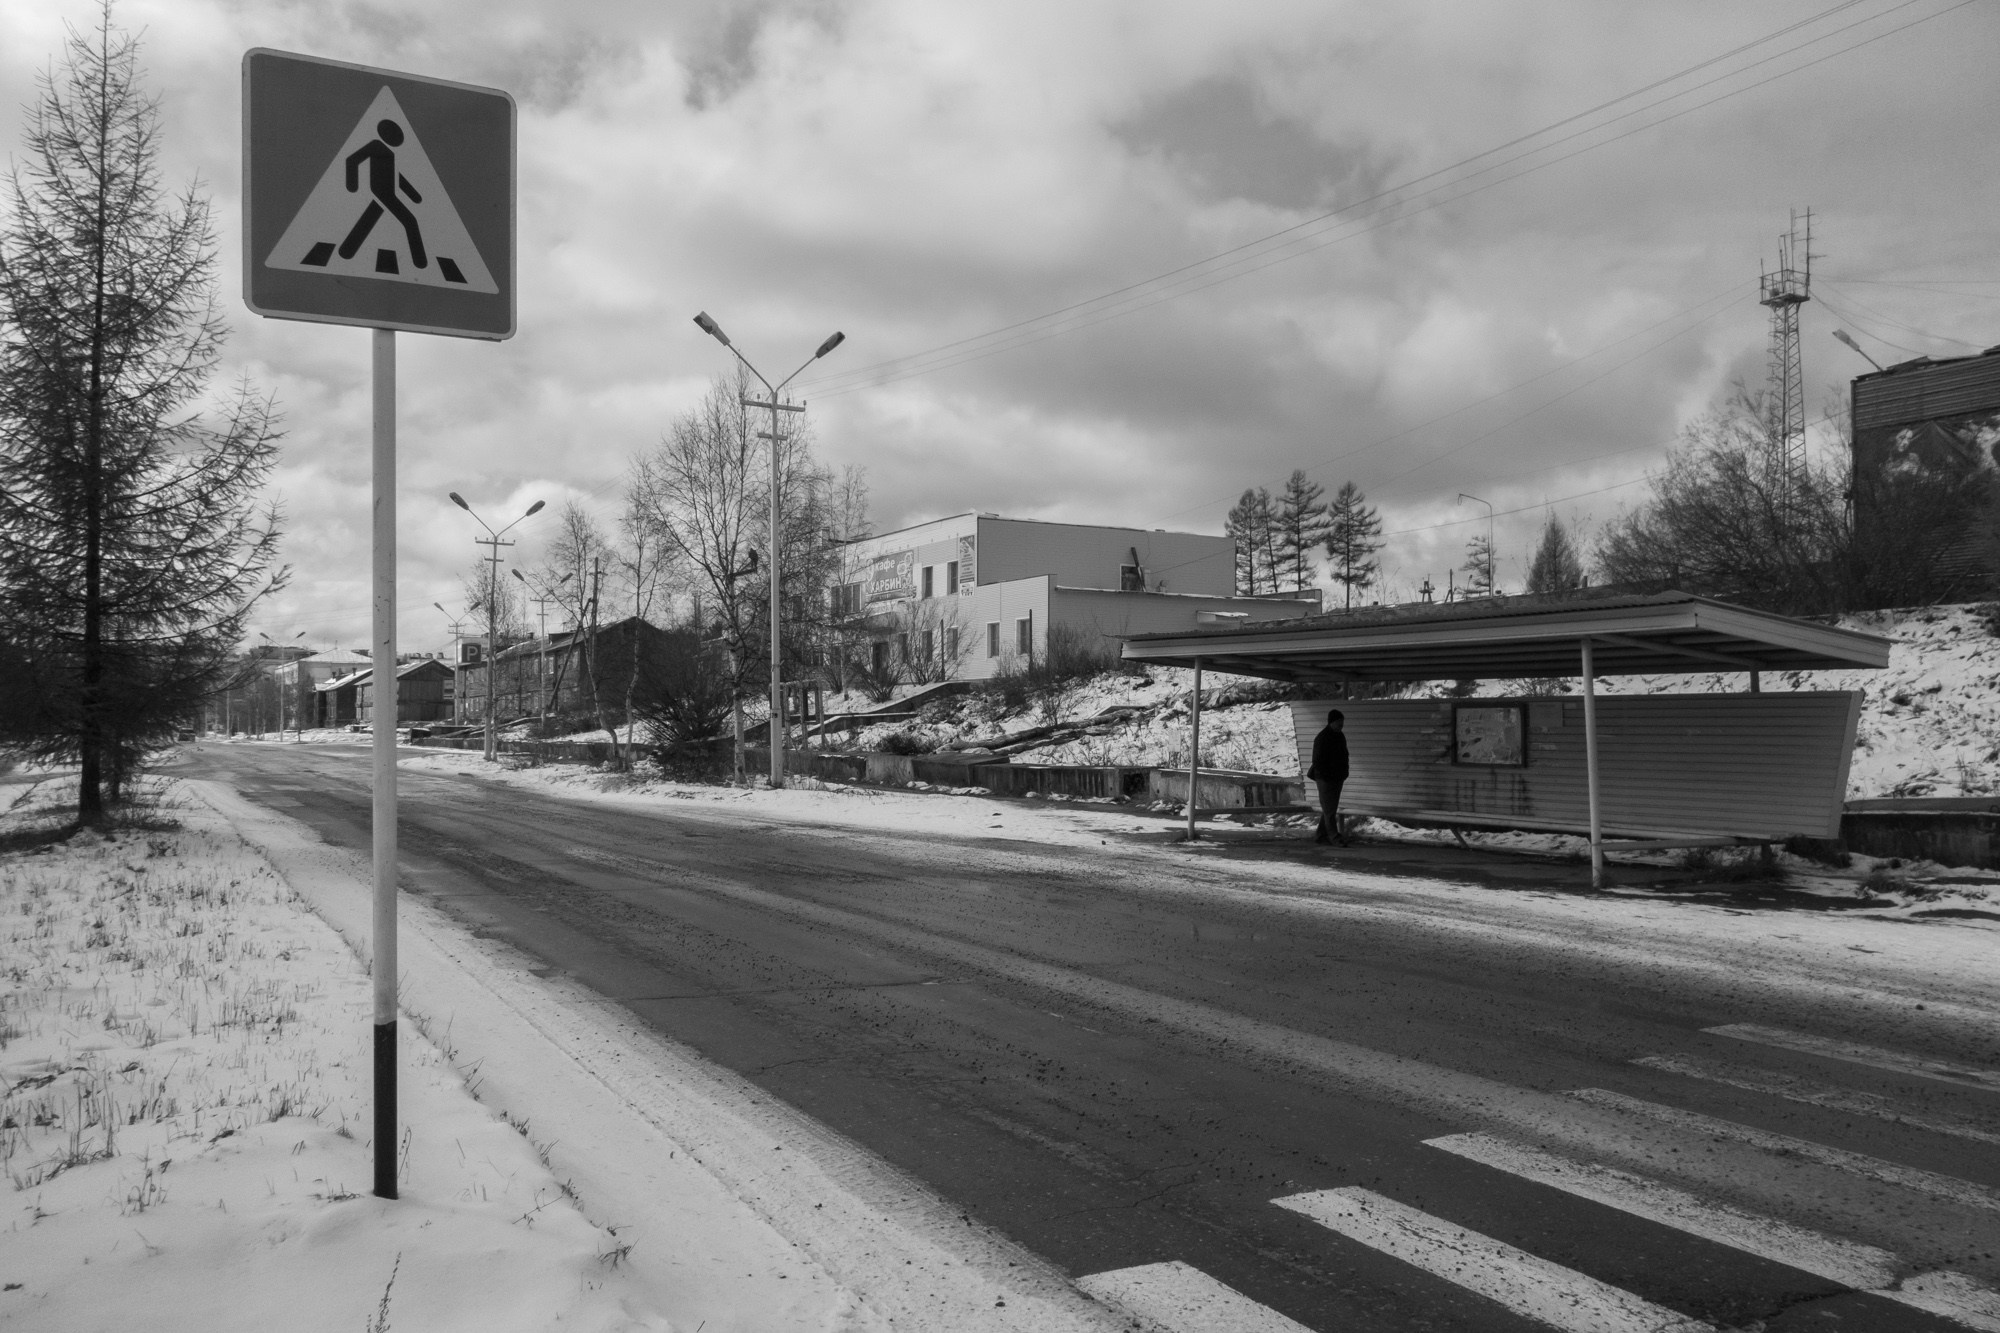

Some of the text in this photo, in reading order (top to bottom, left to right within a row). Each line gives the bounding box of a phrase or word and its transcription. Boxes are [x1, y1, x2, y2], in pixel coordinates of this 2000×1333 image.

[875, 558, 895, 572] кафе
[870, 577, 901, 593] ХАРБИН
[466, 645, 478, 662] P
